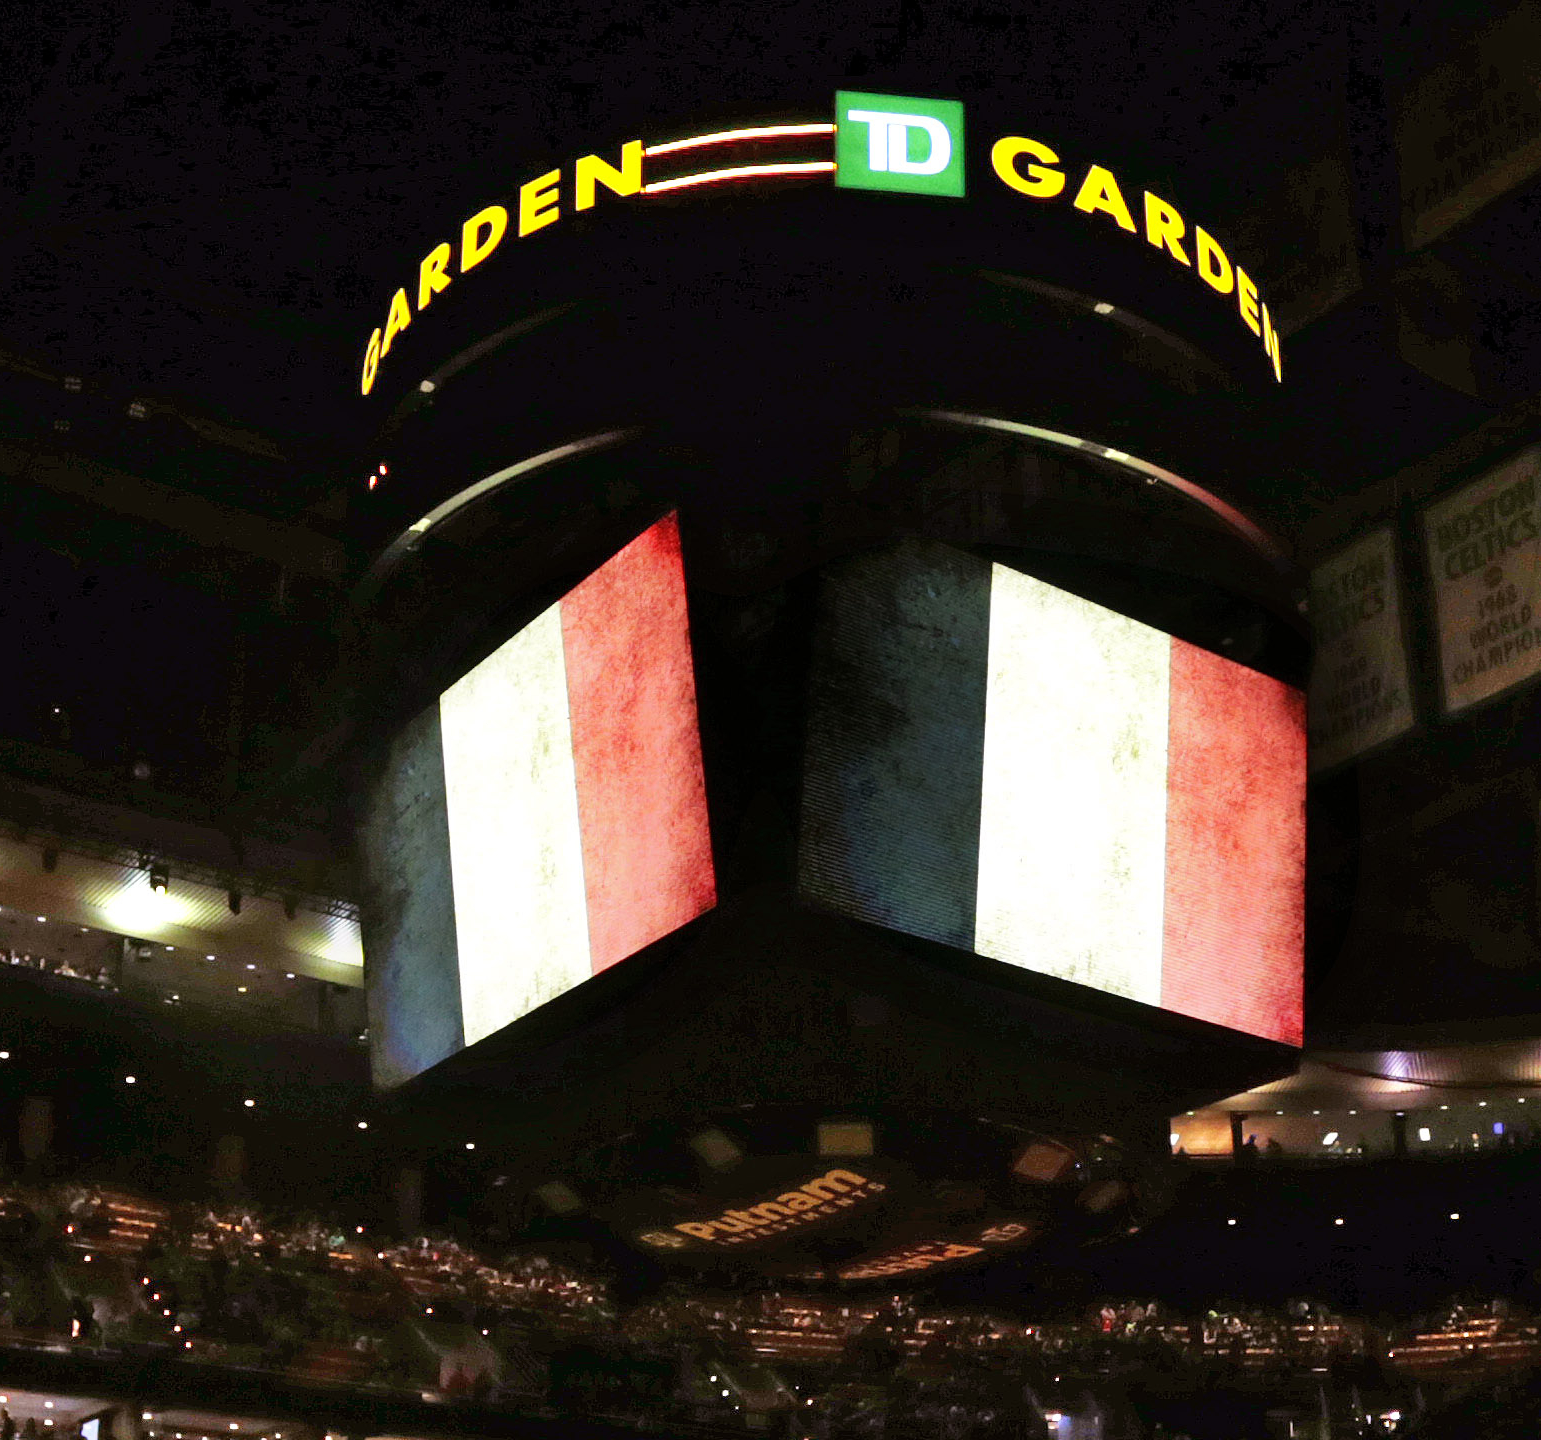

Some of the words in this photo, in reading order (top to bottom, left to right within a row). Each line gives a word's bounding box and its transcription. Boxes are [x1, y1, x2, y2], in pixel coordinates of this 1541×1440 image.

[361, 139, 643, 396] GARDEN
[847, 109, 951, 175] TD
[991, 136, 1282, 383] GARDEN
[1436, 475, 1536, 553] BOSTON
[1444, 511, 1537, 580] CELTICS
[1469, 604, 1532, 650] WORLD
[1477, 583, 1517, 620] 1968
[673, 1167, 868, 1241] Putnam
[714, 1181, 887, 1246] INVESTMENTS
